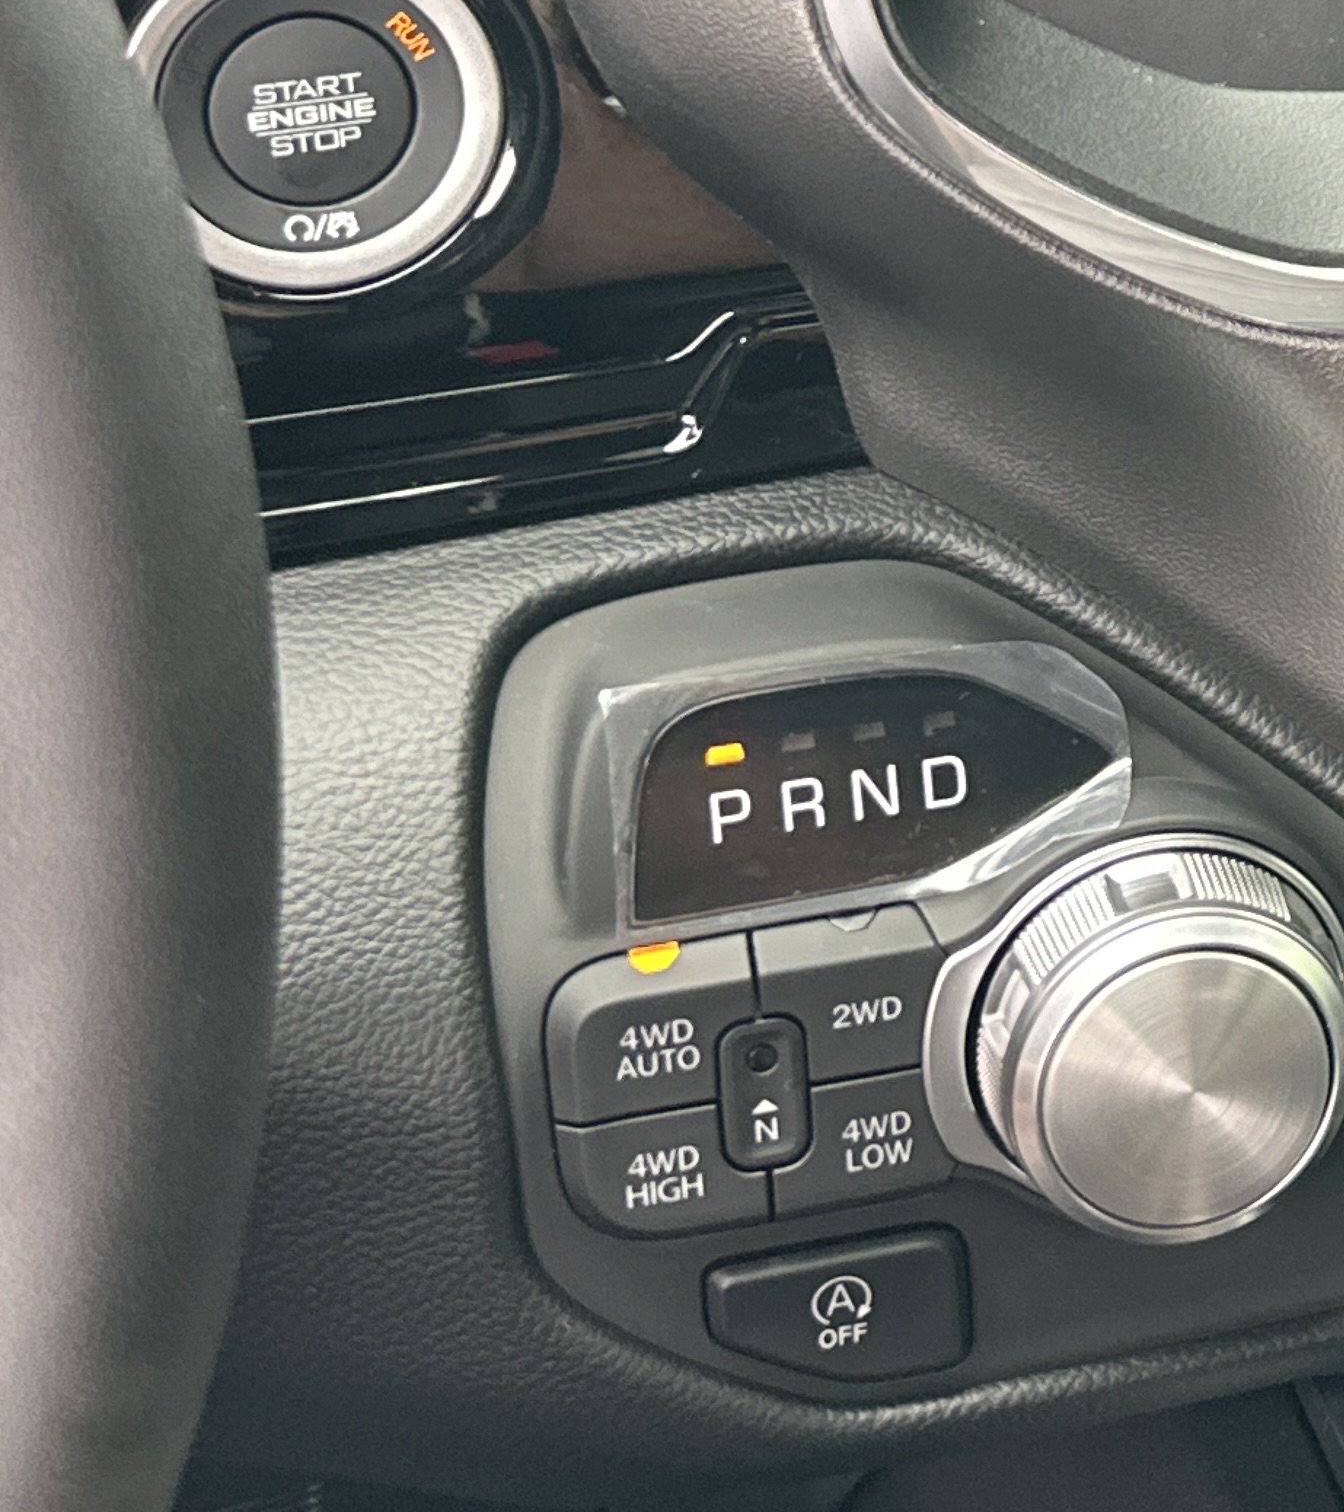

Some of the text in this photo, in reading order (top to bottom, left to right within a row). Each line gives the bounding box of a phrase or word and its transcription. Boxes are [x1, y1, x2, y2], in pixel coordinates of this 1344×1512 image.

[384, 10, 436, 63] RUN
[253, 71, 363, 106] START
[247, 96, 377, 133] ENGINE
[270, 127, 363, 159] STOP
[832, 996, 903, 1030] 2WD
[618, 1017, 695, 1052] 4WD
[616, 1045, 701, 1081] AUTO
[753, 1118, 780, 1144] N
[840, 1110, 912, 1144] 4WD
[627, 1145, 700, 1180] 4WD
[845, 1138, 914, 1173] LOW
[625, 1172, 705, 1210] HIGH
[818, 1321, 870, 1350] OFF
